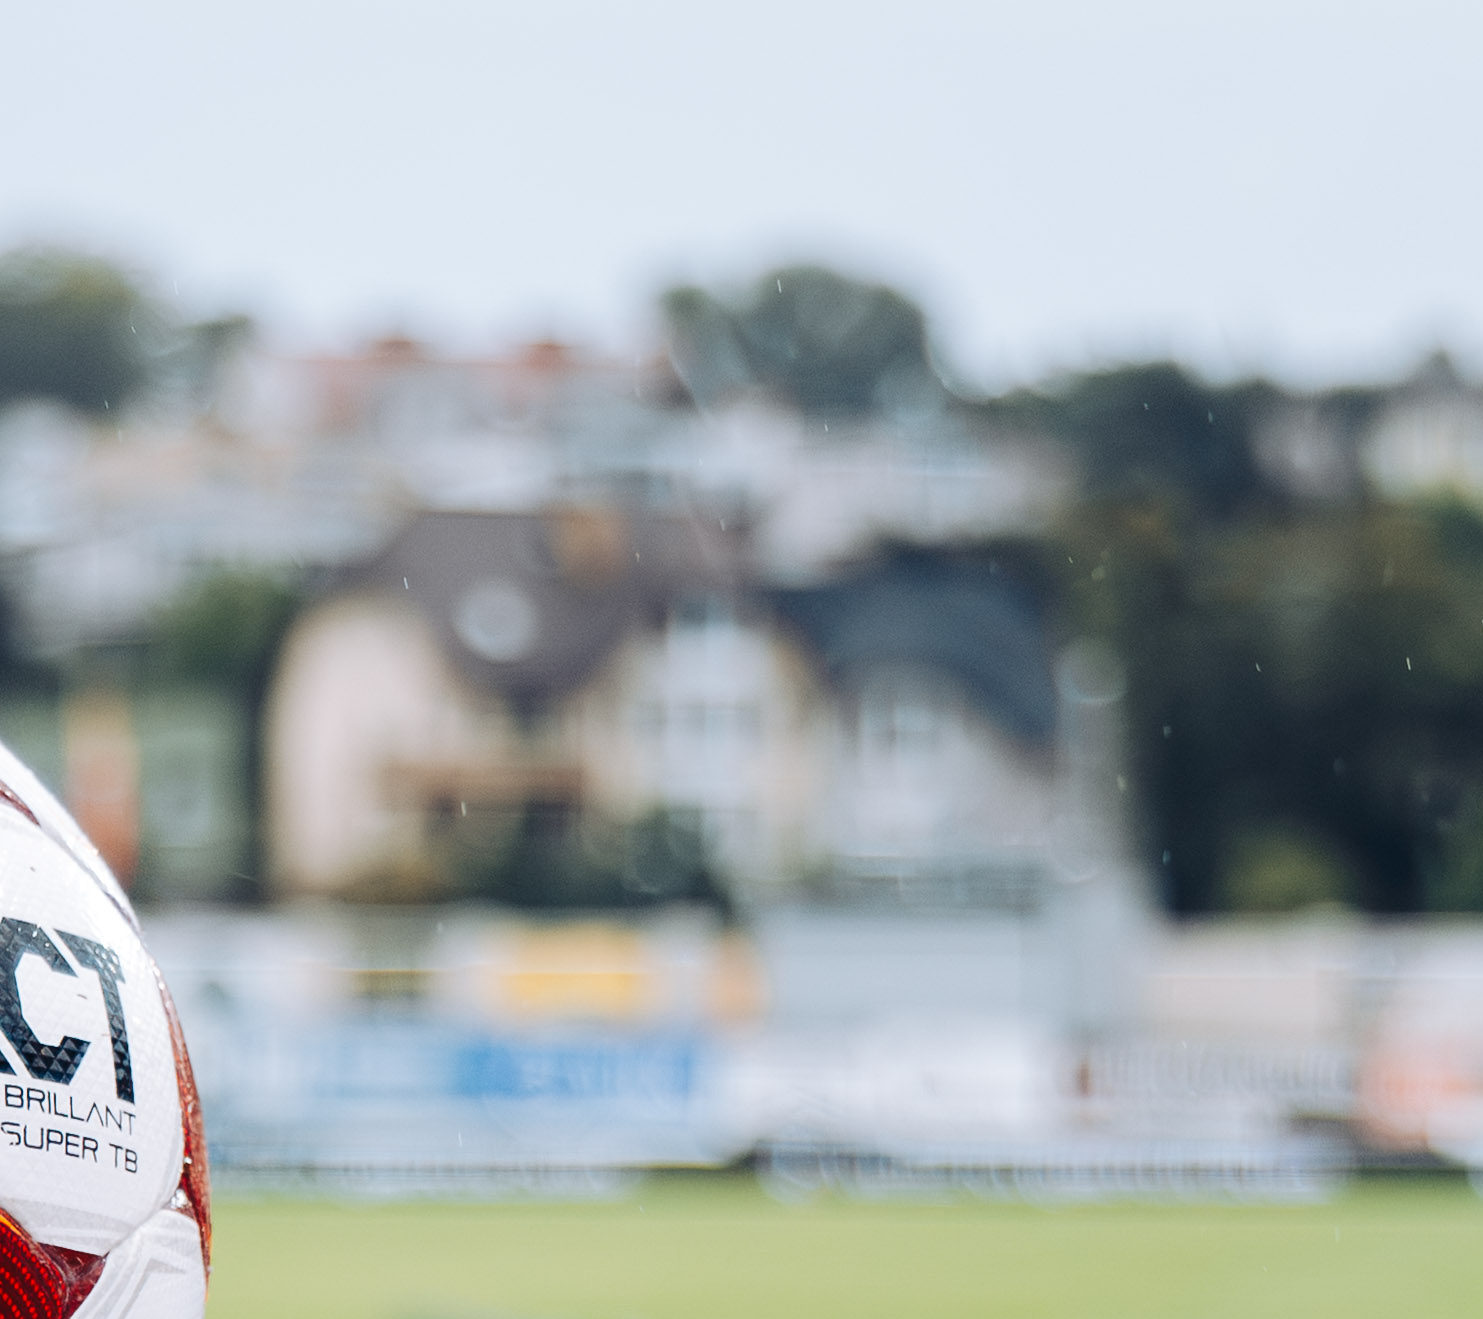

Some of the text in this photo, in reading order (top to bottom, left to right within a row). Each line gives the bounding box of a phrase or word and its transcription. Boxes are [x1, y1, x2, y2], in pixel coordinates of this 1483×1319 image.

[4, 1084, 136, 1136] BRILLANT
[0, 1121, 138, 1174] SUPER TB
